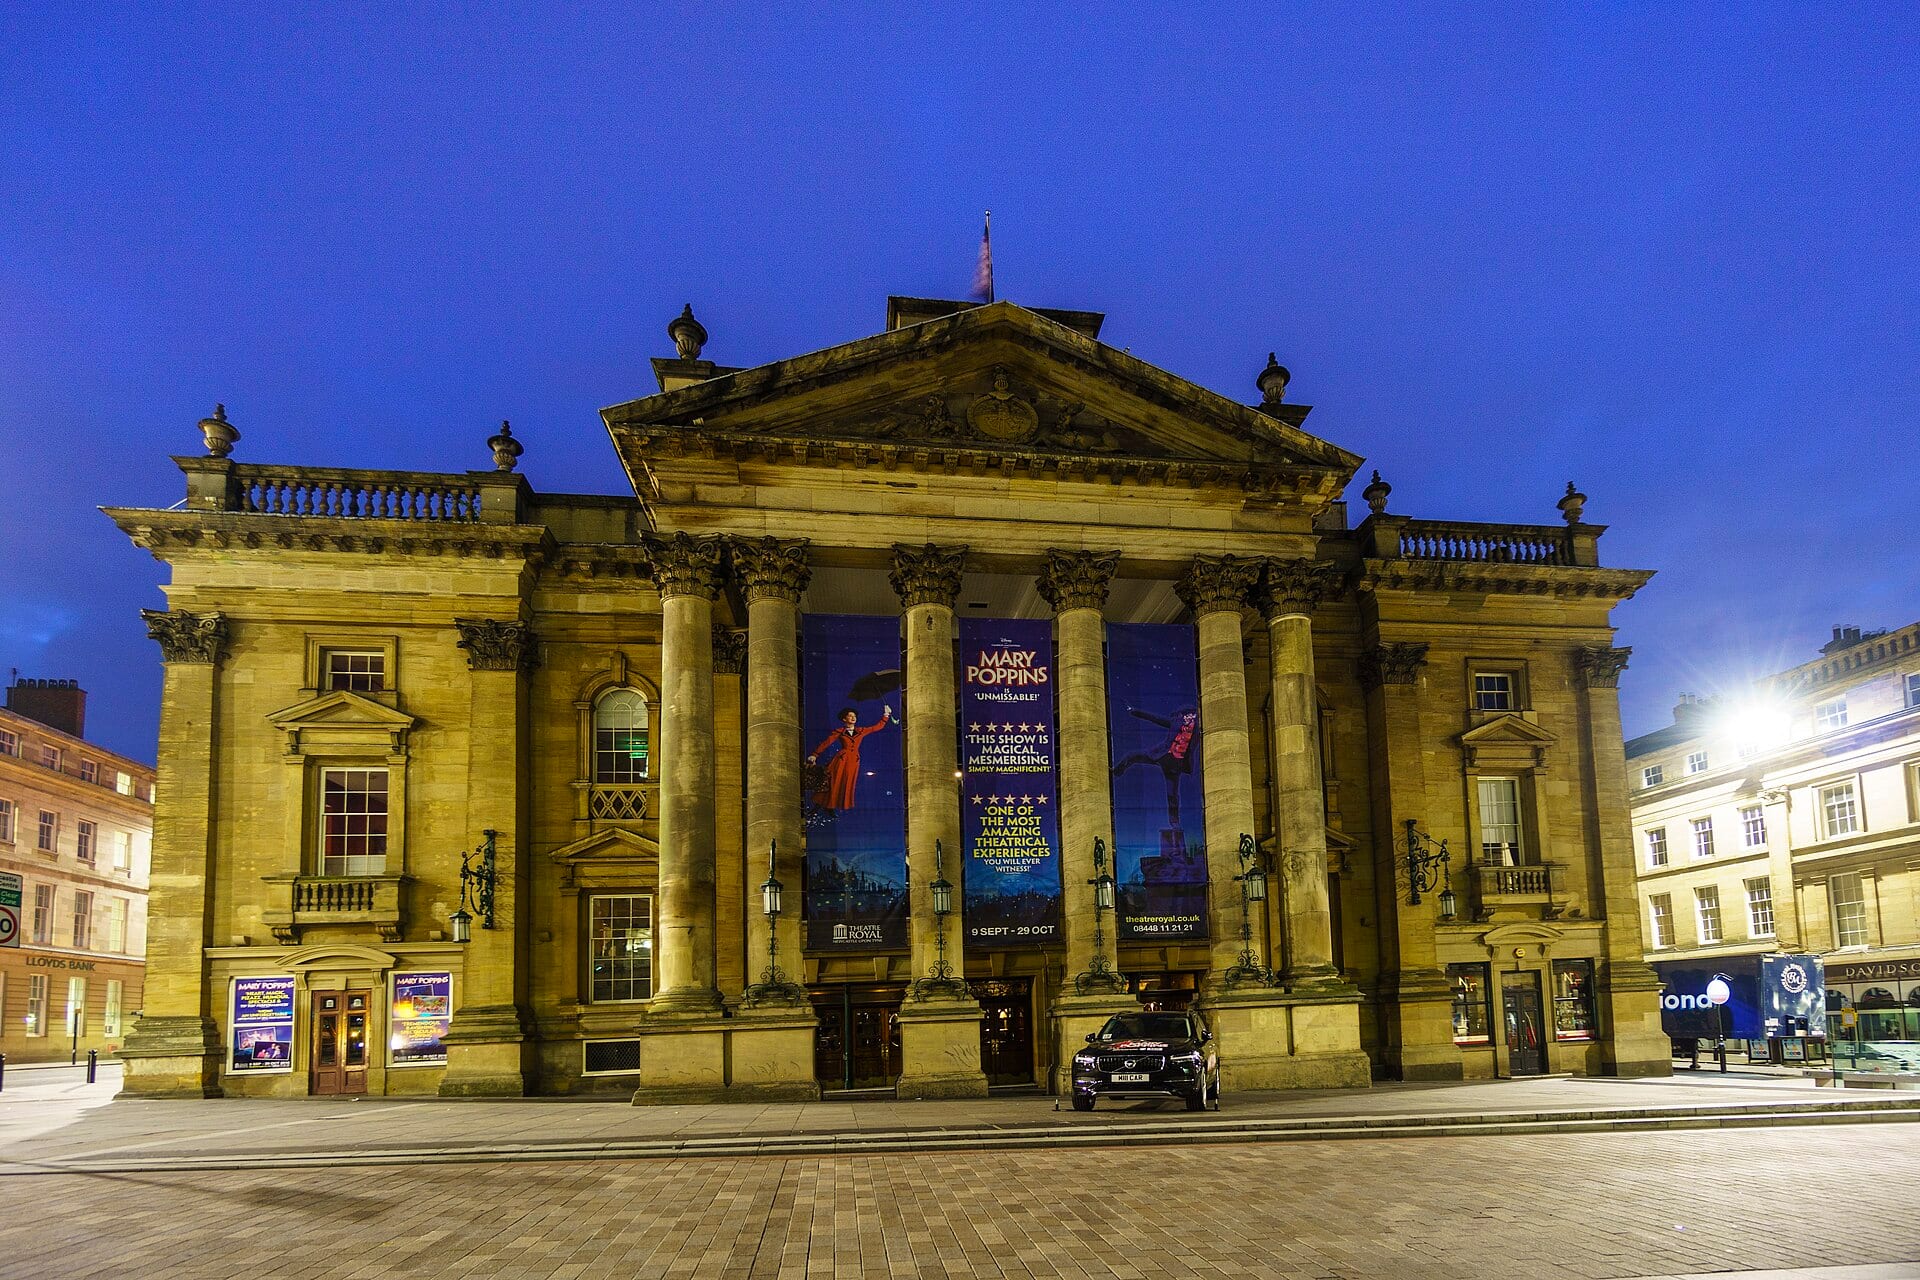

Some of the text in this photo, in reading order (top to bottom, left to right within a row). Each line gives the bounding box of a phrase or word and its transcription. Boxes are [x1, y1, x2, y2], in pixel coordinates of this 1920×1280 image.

[980, 649, 1036, 668] MARY
[967, 666, 1048, 686] POPPINS
[965, 734, 1049, 744] 'THIS SHOW IS
[982, 745, 1039, 755] MAGICAL,
[968, 756, 1049, 765] MESMERISING
[984, 806, 1034, 816] 'ONE OF
[980, 817, 1042, 826] THE MOST
[982, 827, 1040, 836] AMAZING
[975, 837, 1049, 847] THEATRICAL
[974, 848, 1050, 858] EXPERIENCES
[0, 897, 16, 905] Zone
[1126, 915, 1200, 923] theatreroyal.co.uk
[0, 918, 12, 933] 0
[849, 930, 883, 939] ROYAL
[980, 927, 1009, 936] SEPT
[1017, 926, 1030, 935] 29
[1032, 926, 1055, 934] OCT
[26, 956, 96, 972] LLOYDS BANK
[262, 981, 294, 989] POPPINS
